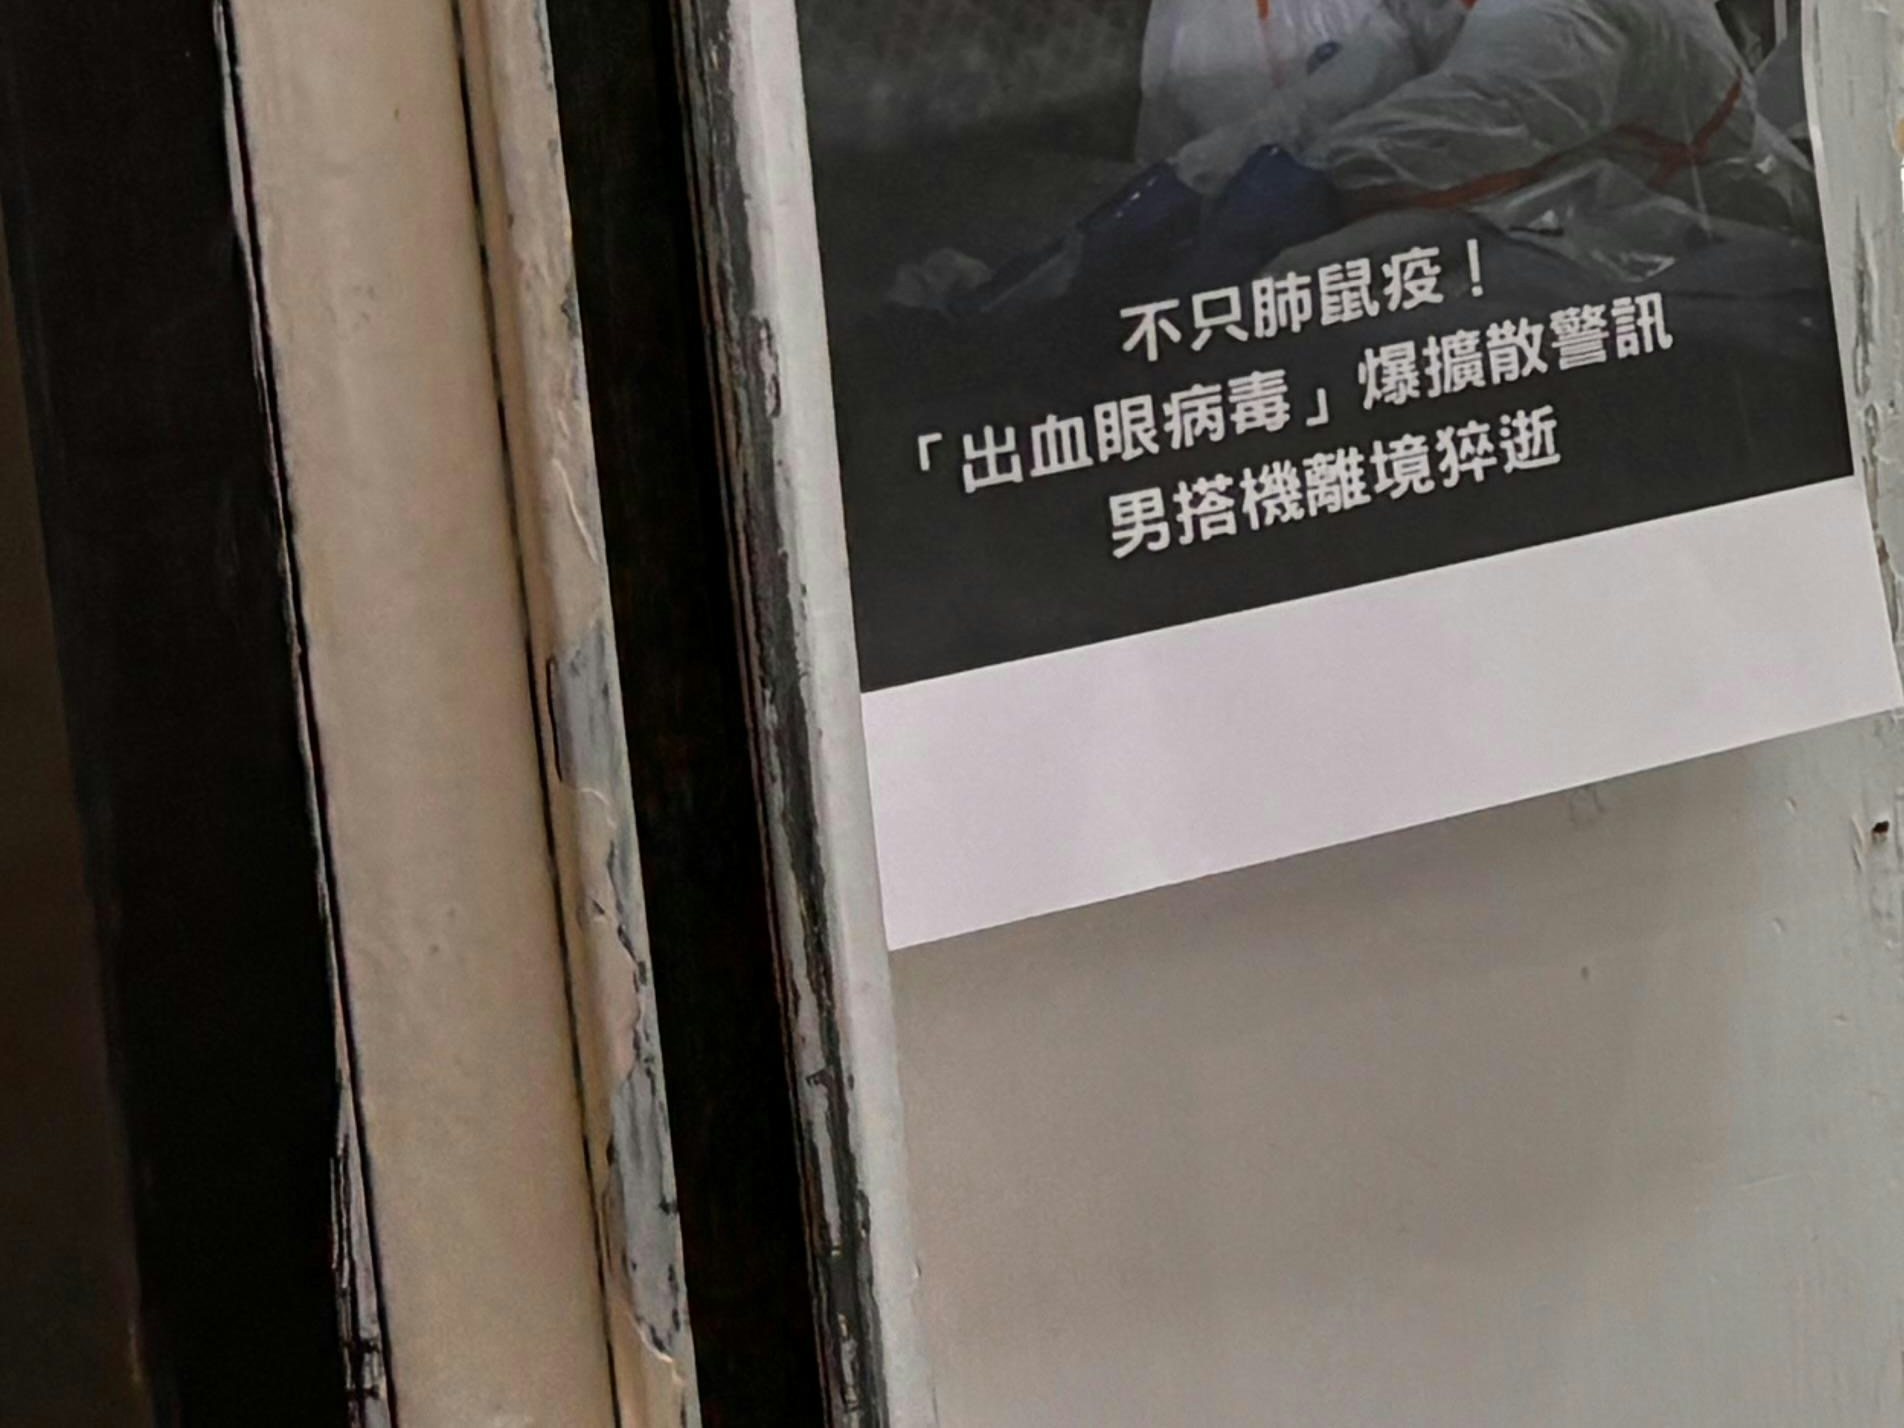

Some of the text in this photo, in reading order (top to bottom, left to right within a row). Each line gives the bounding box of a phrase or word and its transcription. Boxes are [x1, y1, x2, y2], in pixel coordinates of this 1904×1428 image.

[1119, 235, 1487, 365] 不只肺鼠疫！
[916, 291, 1674, 495] 「出血眼病毒」爆擴散警訊
[1108, 403, 1562, 562] 男搭機離境猝逝
